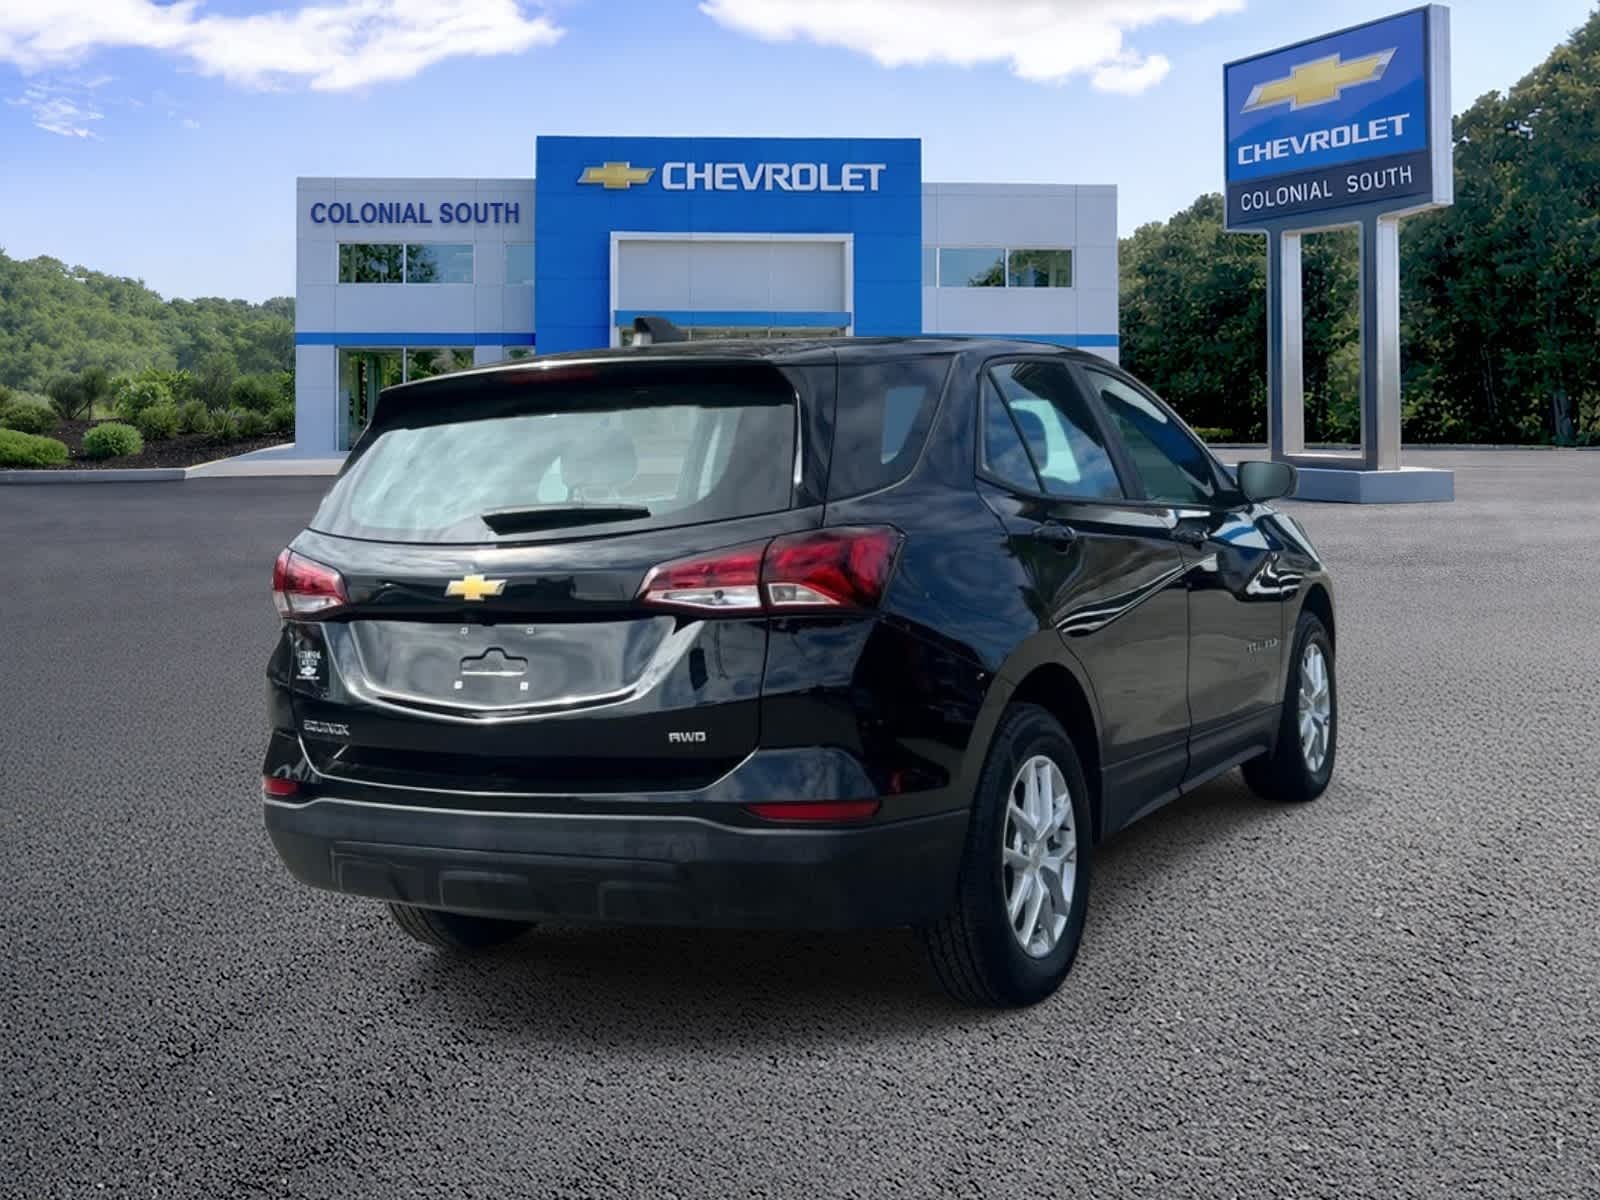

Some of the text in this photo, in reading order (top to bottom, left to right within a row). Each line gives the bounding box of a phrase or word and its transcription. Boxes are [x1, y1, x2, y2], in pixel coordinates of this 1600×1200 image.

[1237, 113, 1410, 165] CHEVROLET
[662, 161, 887, 192] CHEVROLET
[1240, 165, 1412, 211] COLONIAL SOUTH
[310, 202, 520, 224] COLONIAL SOUTH
[668, 731, 706, 743] AWD
